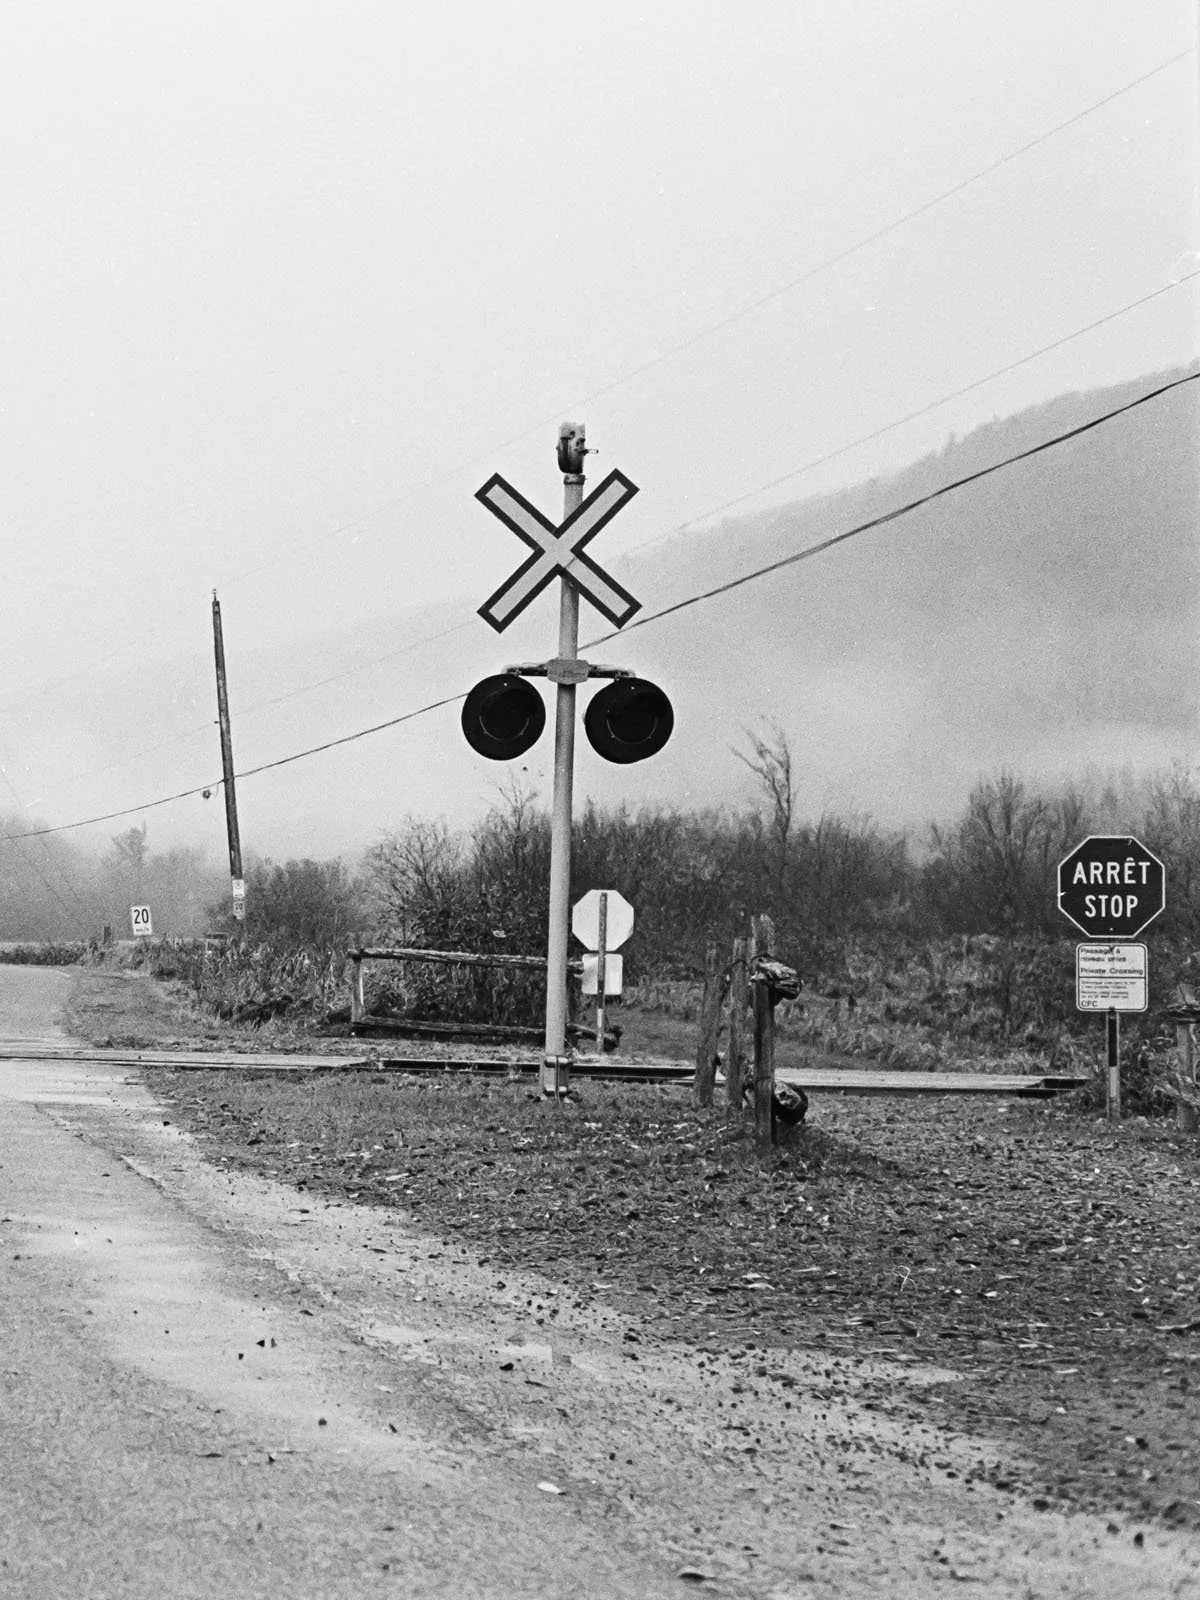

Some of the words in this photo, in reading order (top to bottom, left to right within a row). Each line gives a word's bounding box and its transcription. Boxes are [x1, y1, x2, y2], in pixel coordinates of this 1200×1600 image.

[1073, 856, 1151, 885] ARRÊT
[133, 908, 149, 924] 20
[1084, 894, 1139, 918] STOP
[1109, 967, 1144, 976] Crossing
